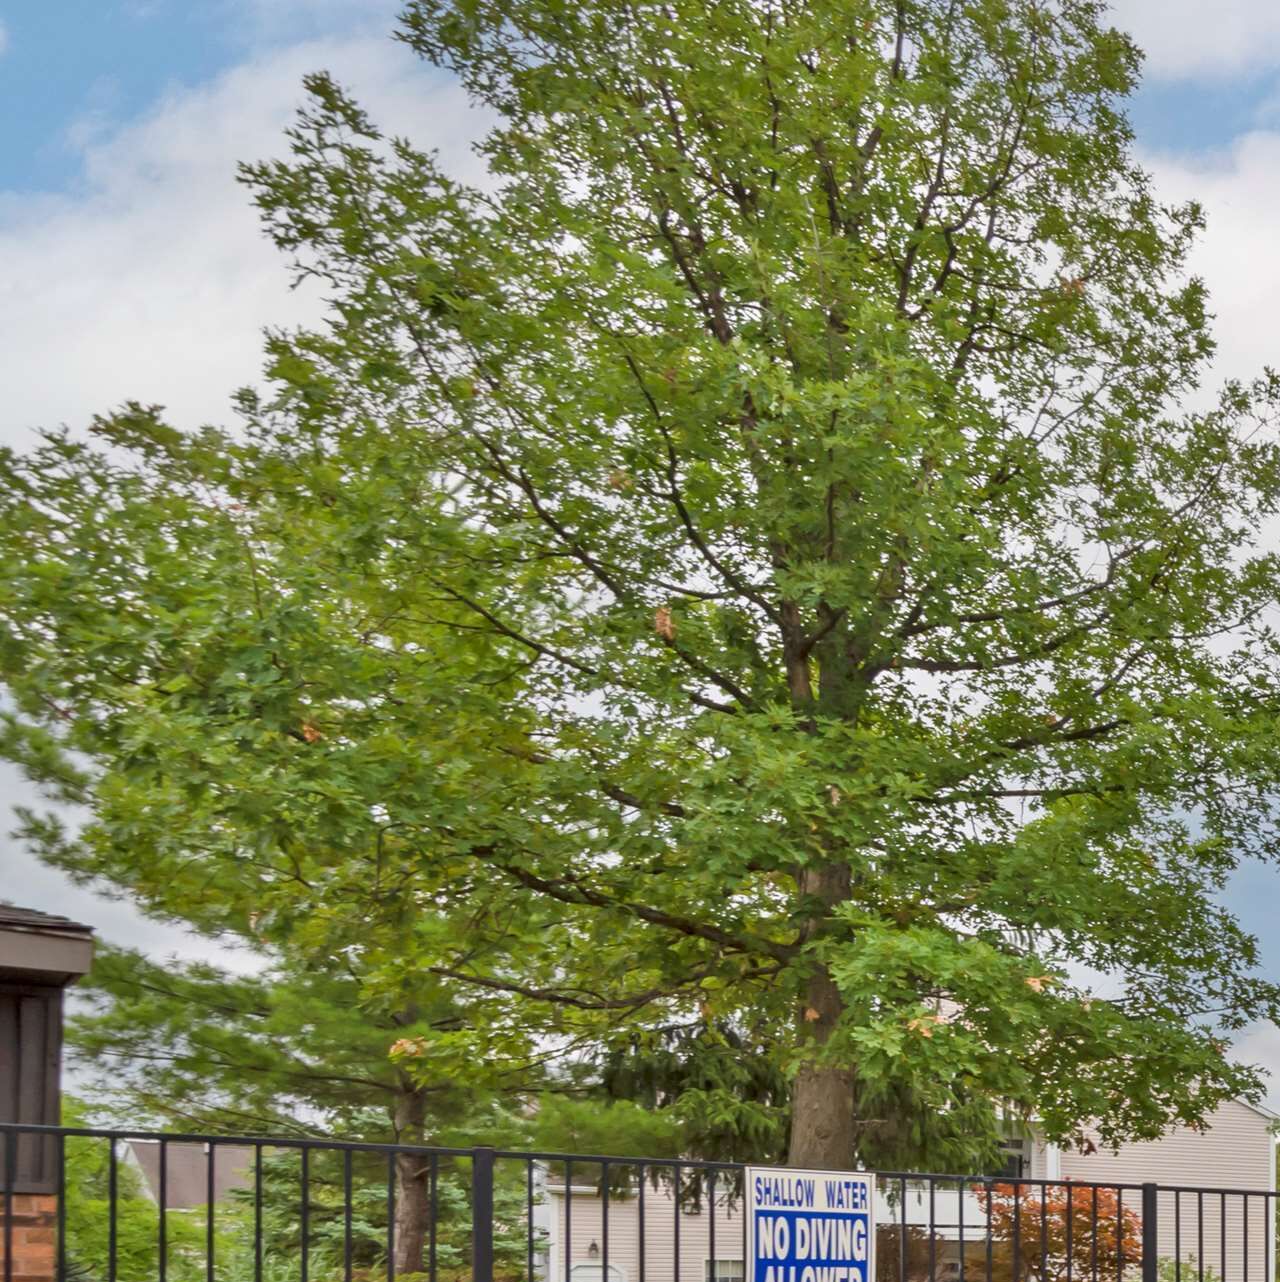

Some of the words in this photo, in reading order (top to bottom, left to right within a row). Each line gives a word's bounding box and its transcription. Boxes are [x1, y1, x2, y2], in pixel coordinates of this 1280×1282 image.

[755, 1176, 815, 1207] SHALLOW
[825, 1180, 868, 1209] WATER
[758, 1216, 790, 1260] NO
[795, 1217, 866, 1262] DIVING
